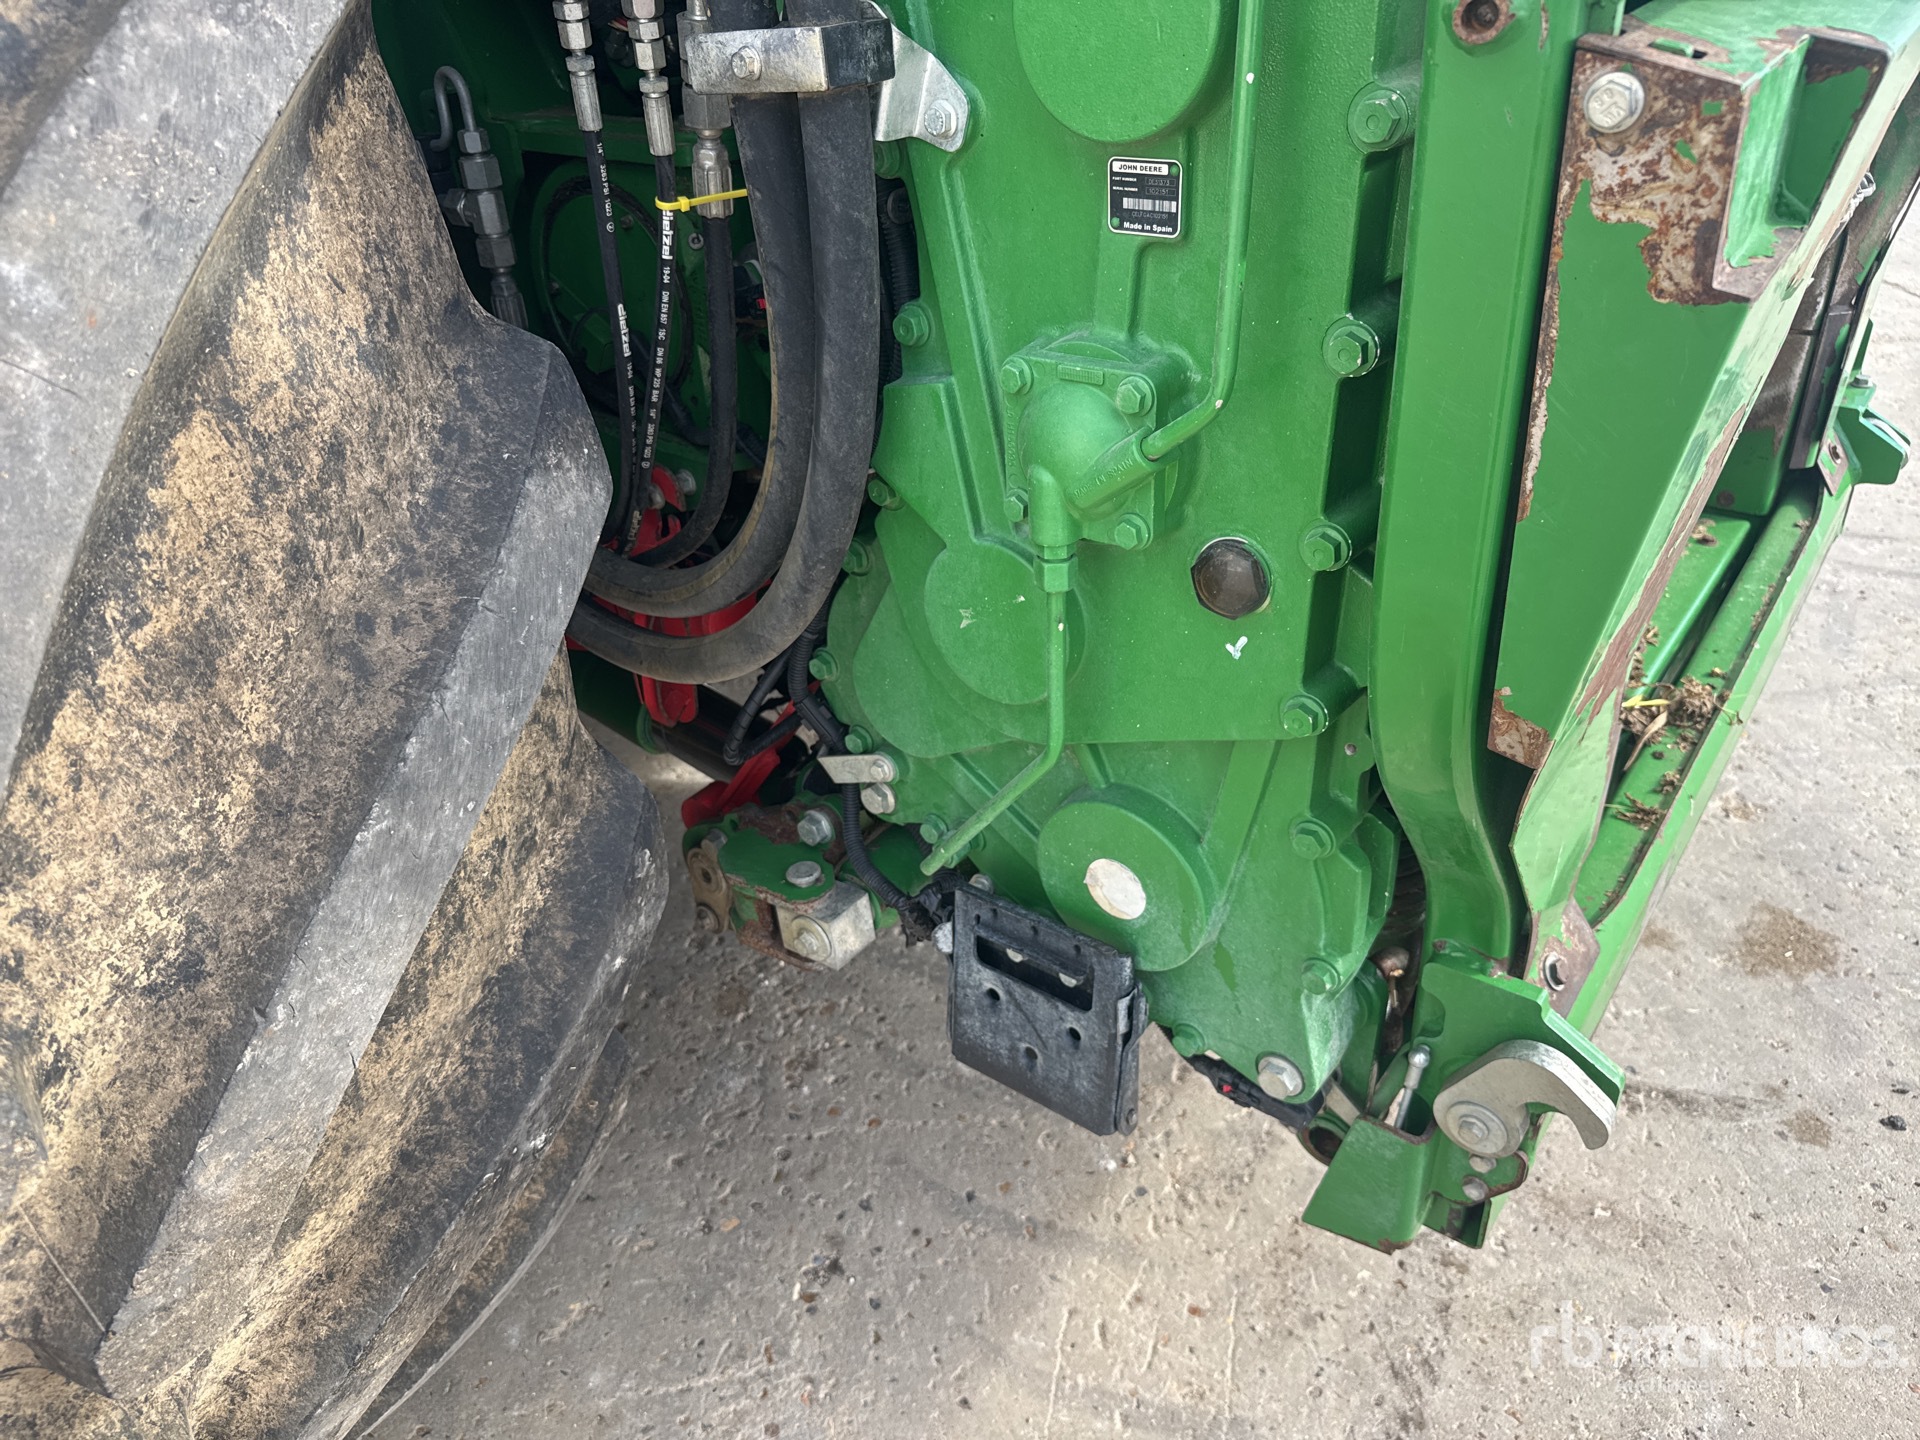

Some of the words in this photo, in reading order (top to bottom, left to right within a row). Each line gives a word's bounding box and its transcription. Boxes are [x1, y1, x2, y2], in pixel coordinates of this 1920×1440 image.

[1139, 165, 1163, 173] DEERE
[1123, 221, 1143, 230] Made
[1143, 223, 1151, 231] in
[1152, 224, 1173, 233] Spain
[661, 291, 670, 303] DIN
[660, 303, 669, 313] EN
[617, 303, 632, 358] dietzel
[656, 347, 665, 357] DN
[650, 389, 660, 403] BAR
[1107, 458, 1134, 478] SPAIN
